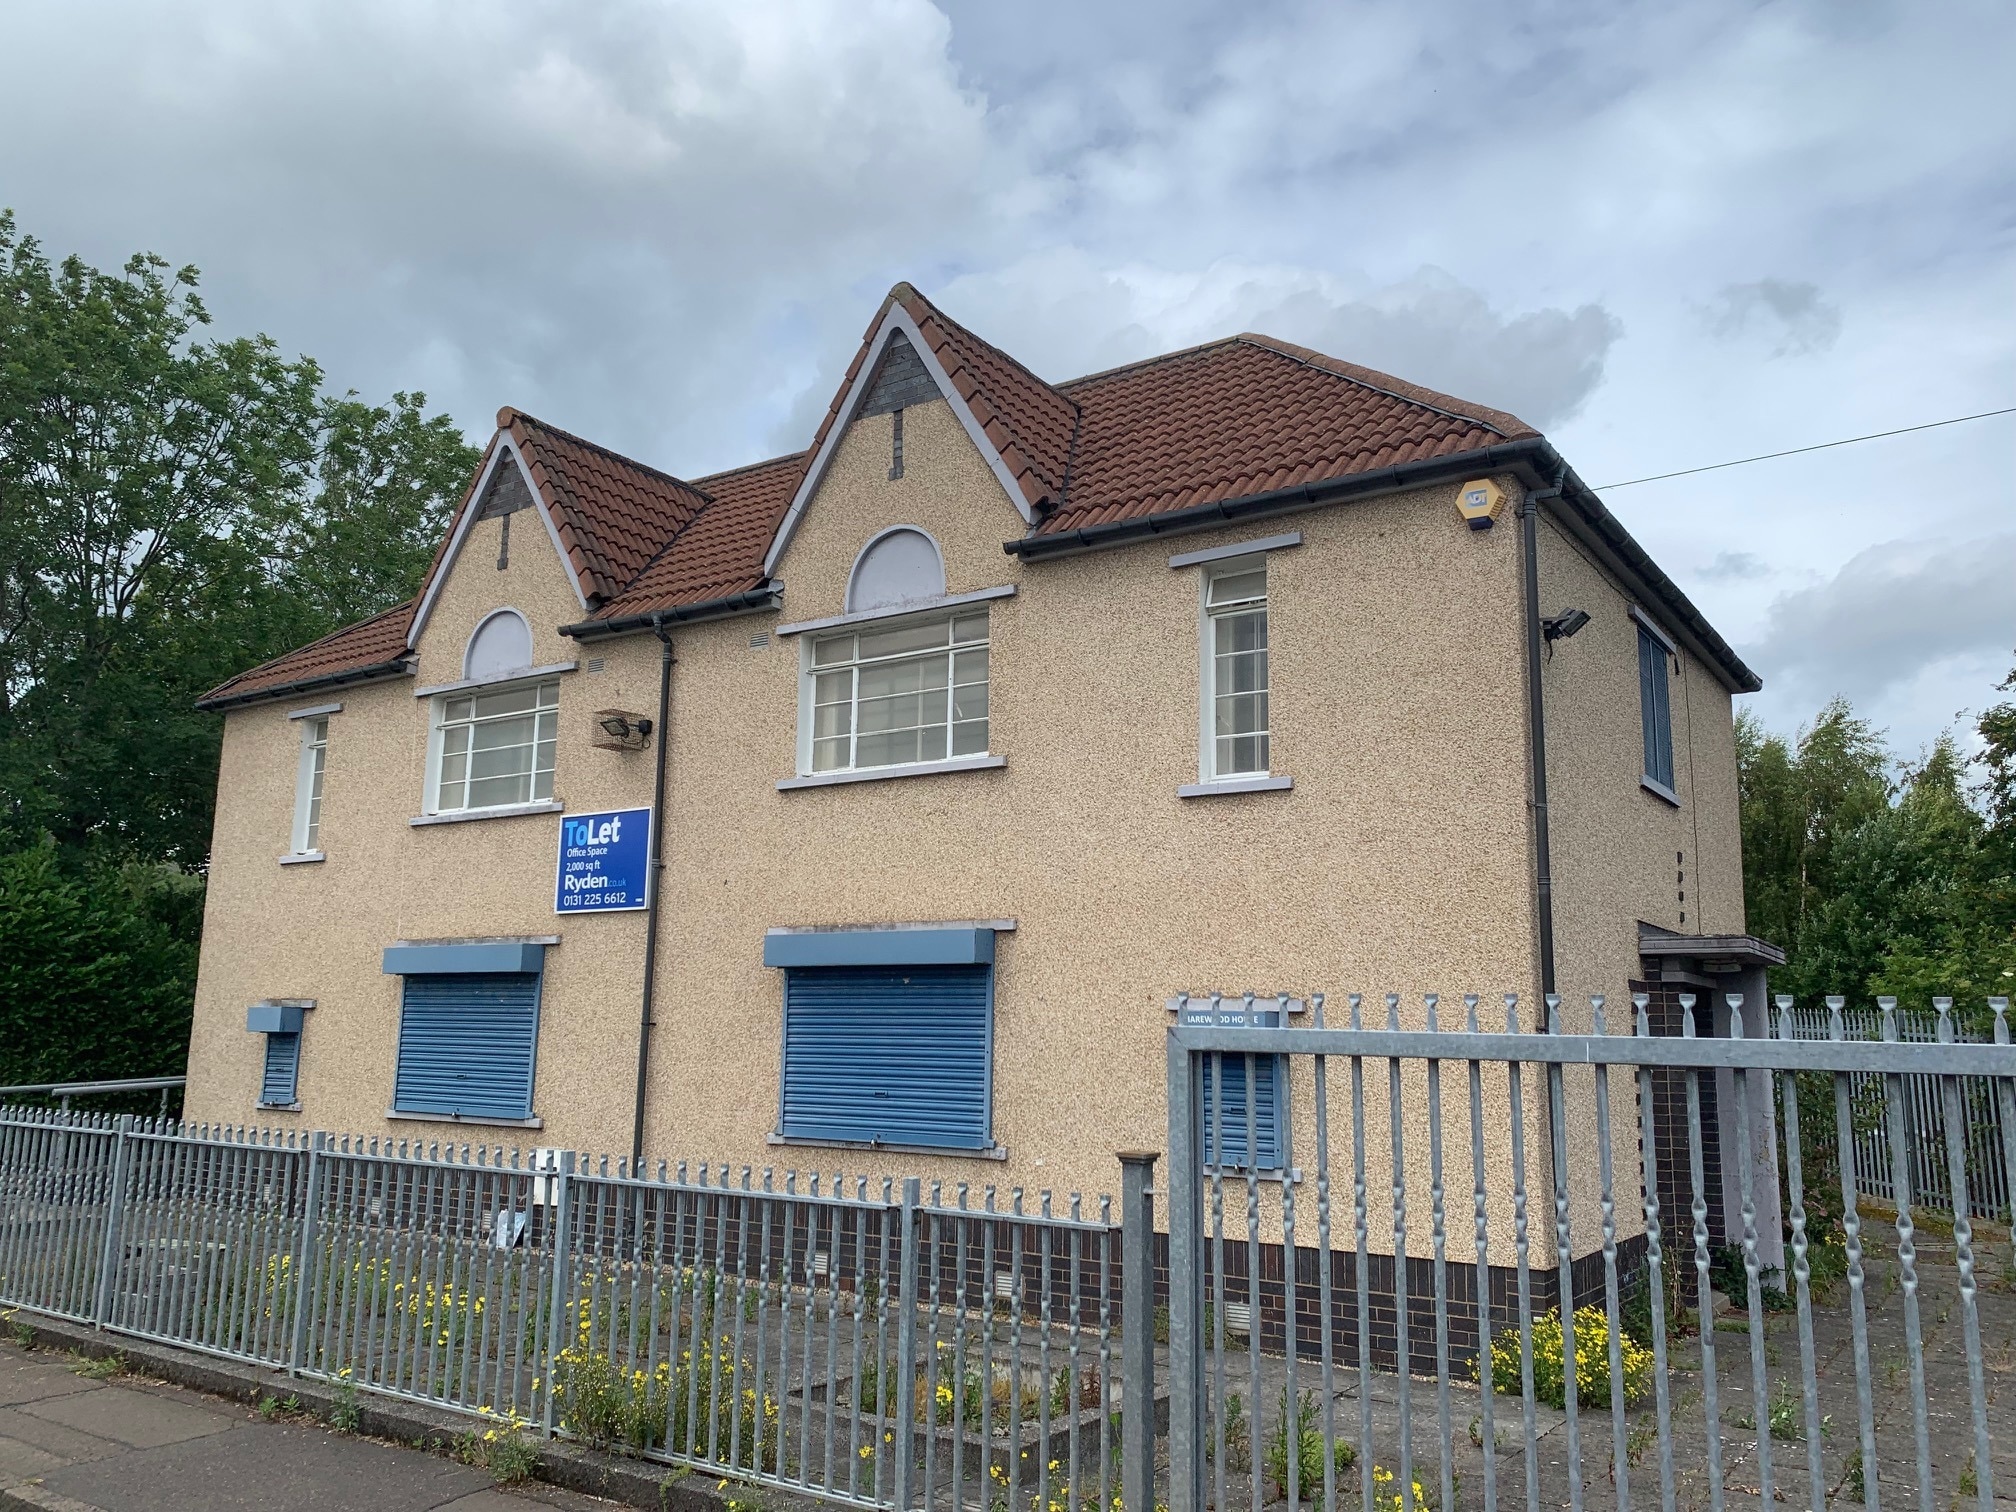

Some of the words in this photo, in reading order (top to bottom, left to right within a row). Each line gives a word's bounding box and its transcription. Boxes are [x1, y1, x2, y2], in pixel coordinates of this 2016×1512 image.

[567, 847, 586, 857] Office
[587, 846, 608, 857] Space
[566, 861, 584, 872] 2,000
[585, 861, 594, 871] sq
[594, 859, 601, 870] ft
[563, 894, 582, 906] 0131
[584, 894, 602, 905] 225
[604, 892, 626, 904] 6612
